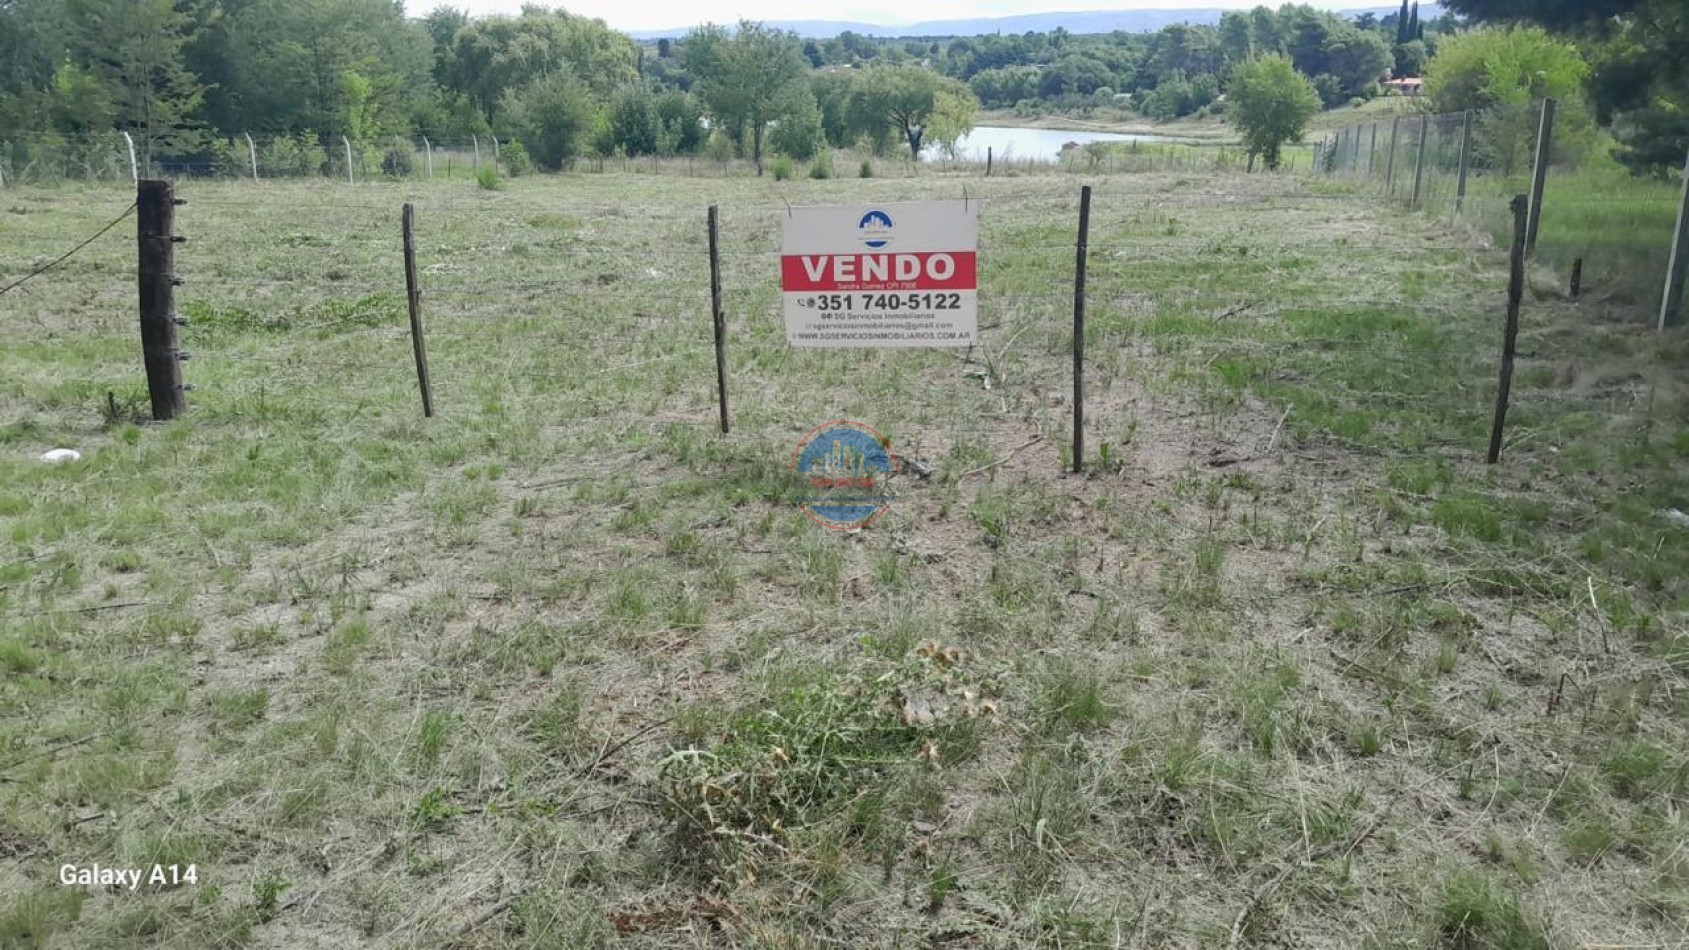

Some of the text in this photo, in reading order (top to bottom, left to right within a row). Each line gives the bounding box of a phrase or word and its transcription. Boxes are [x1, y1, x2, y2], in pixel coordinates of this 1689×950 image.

[801, 253, 955, 281] VENDO
[817, 293, 961, 311] 351 740-5122
[834, 312, 935, 321] SG Servicios Inmobiliarios
[798, 331, 971, 341] WWW.SGSERVICIOSINMOBILIARIOS.COM.AR
